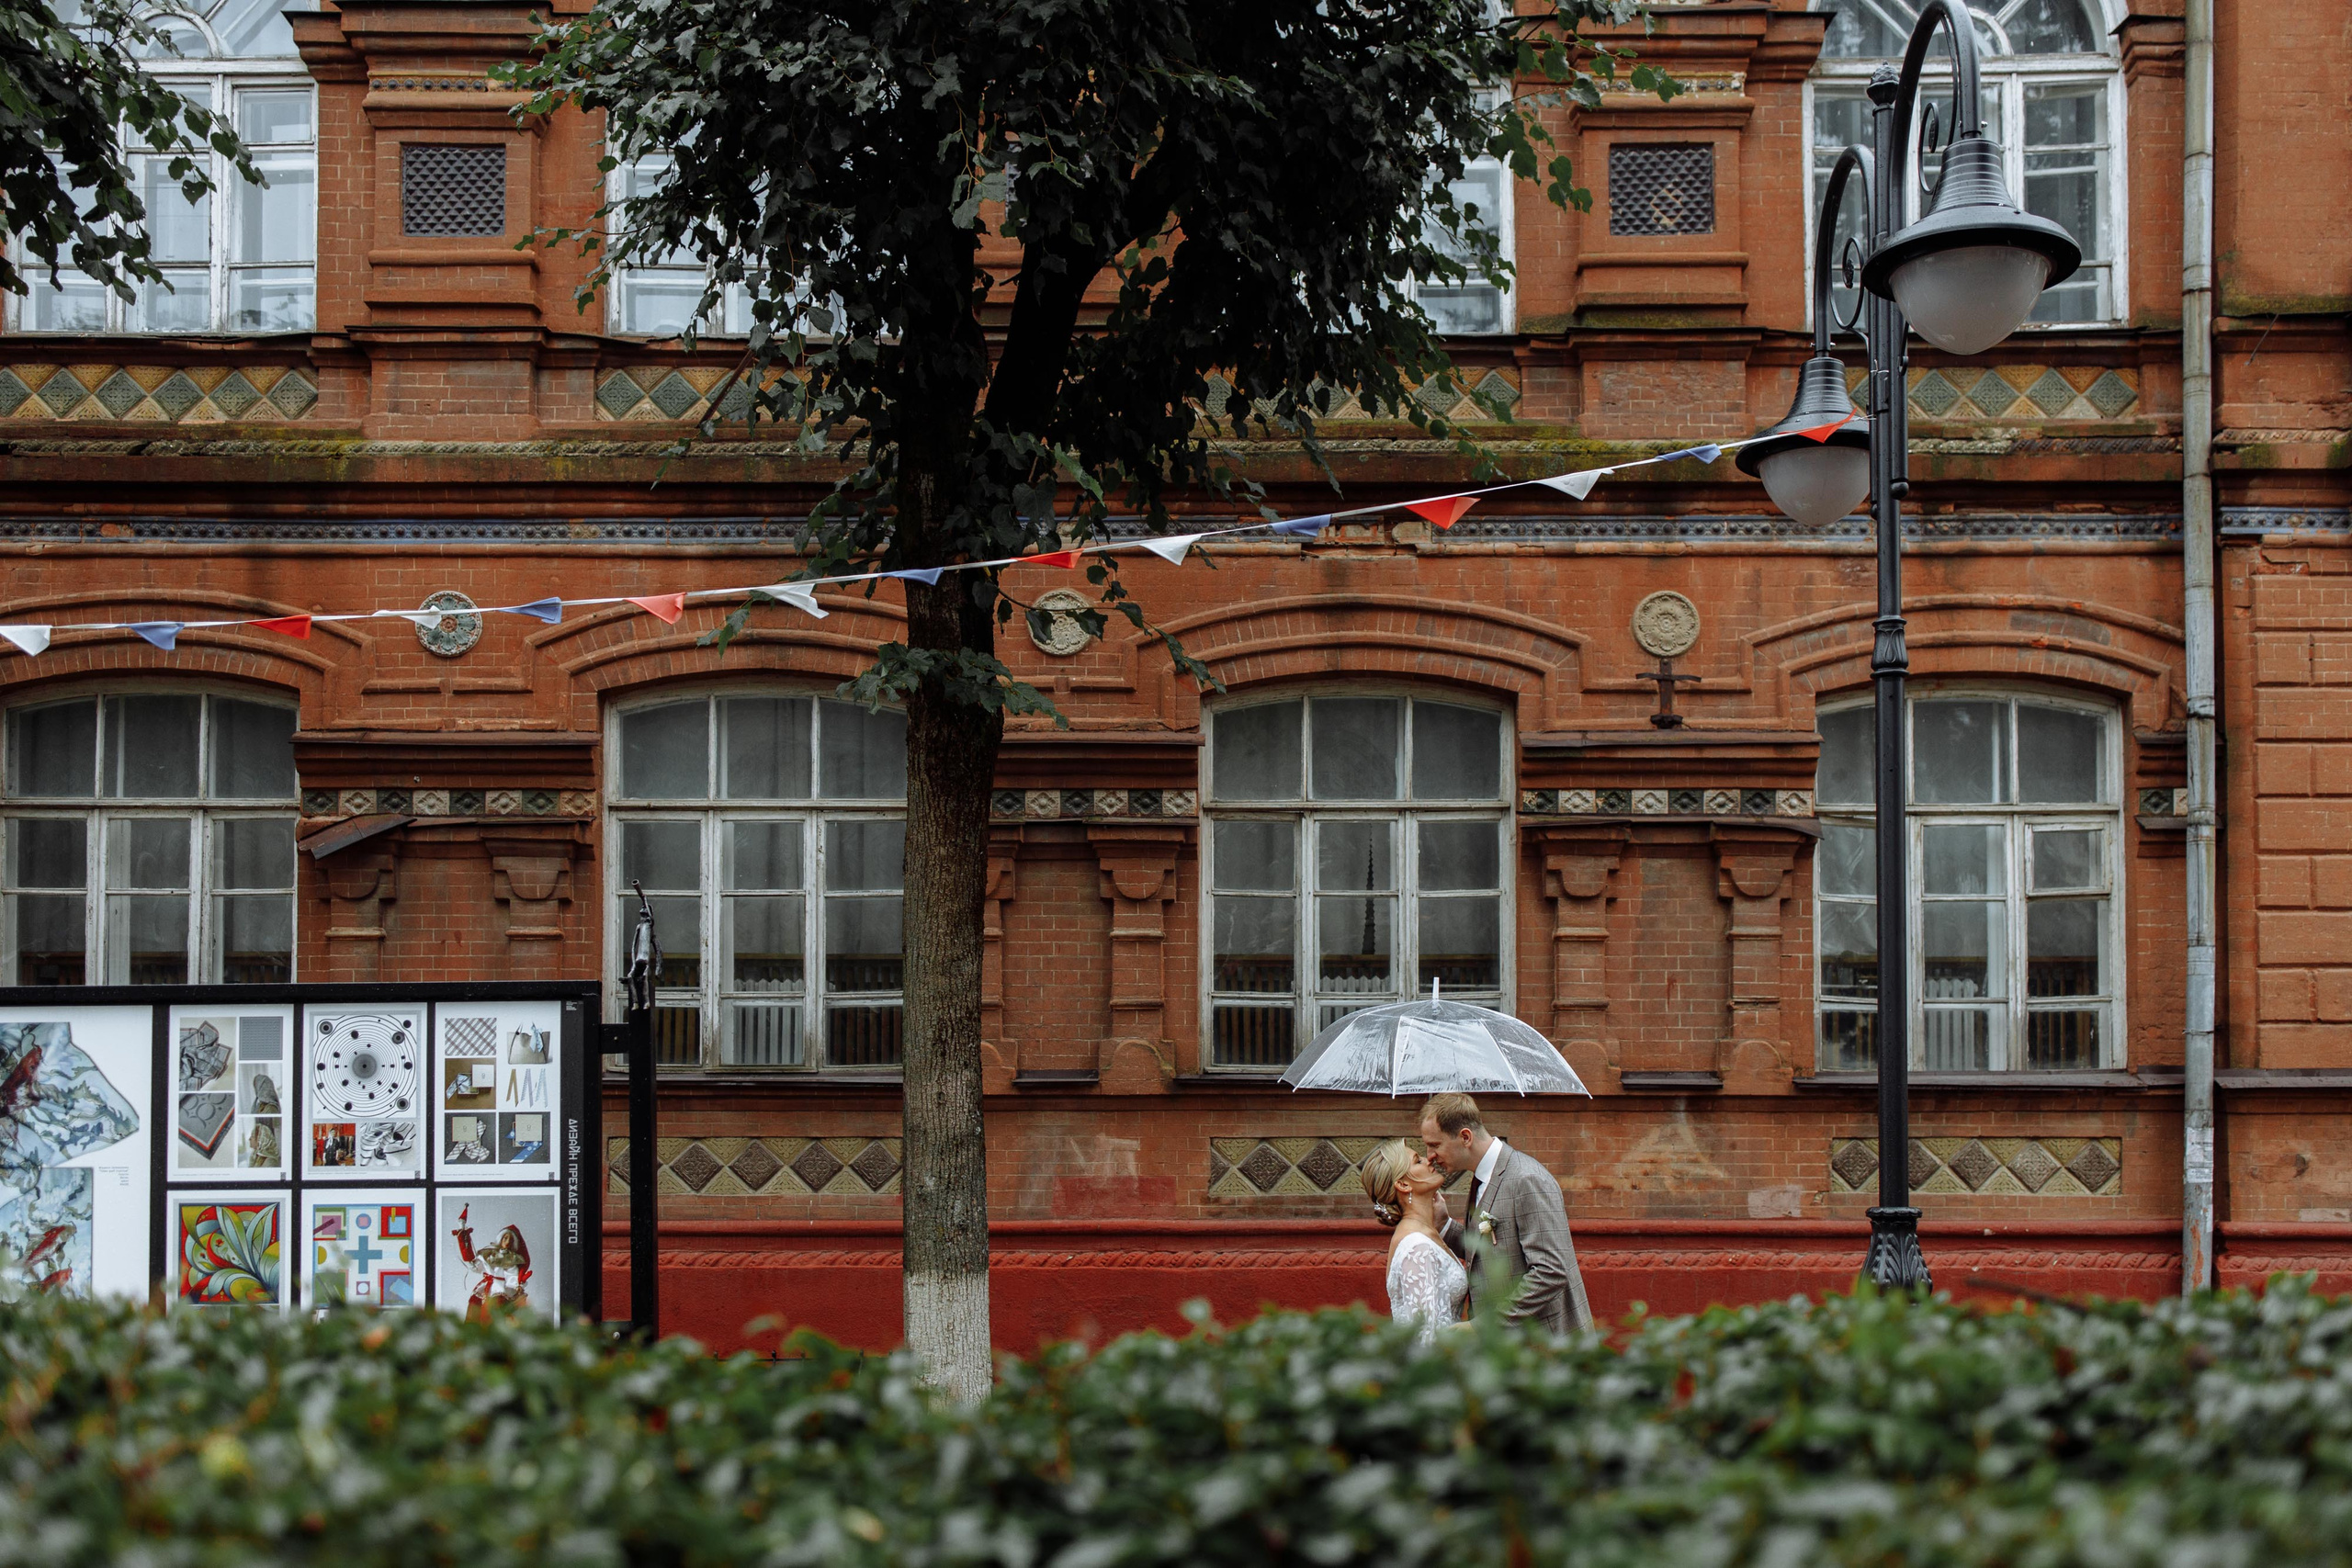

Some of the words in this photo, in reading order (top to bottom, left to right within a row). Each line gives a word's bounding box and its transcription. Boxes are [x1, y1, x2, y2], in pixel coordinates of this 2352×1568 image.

[568, 1118, 581, 1160] ДИЗАЙН
[568, 1163, 578, 1205] ПРЕЖДЕ
[568, 1208, 578, 1244] ВСЕГО
